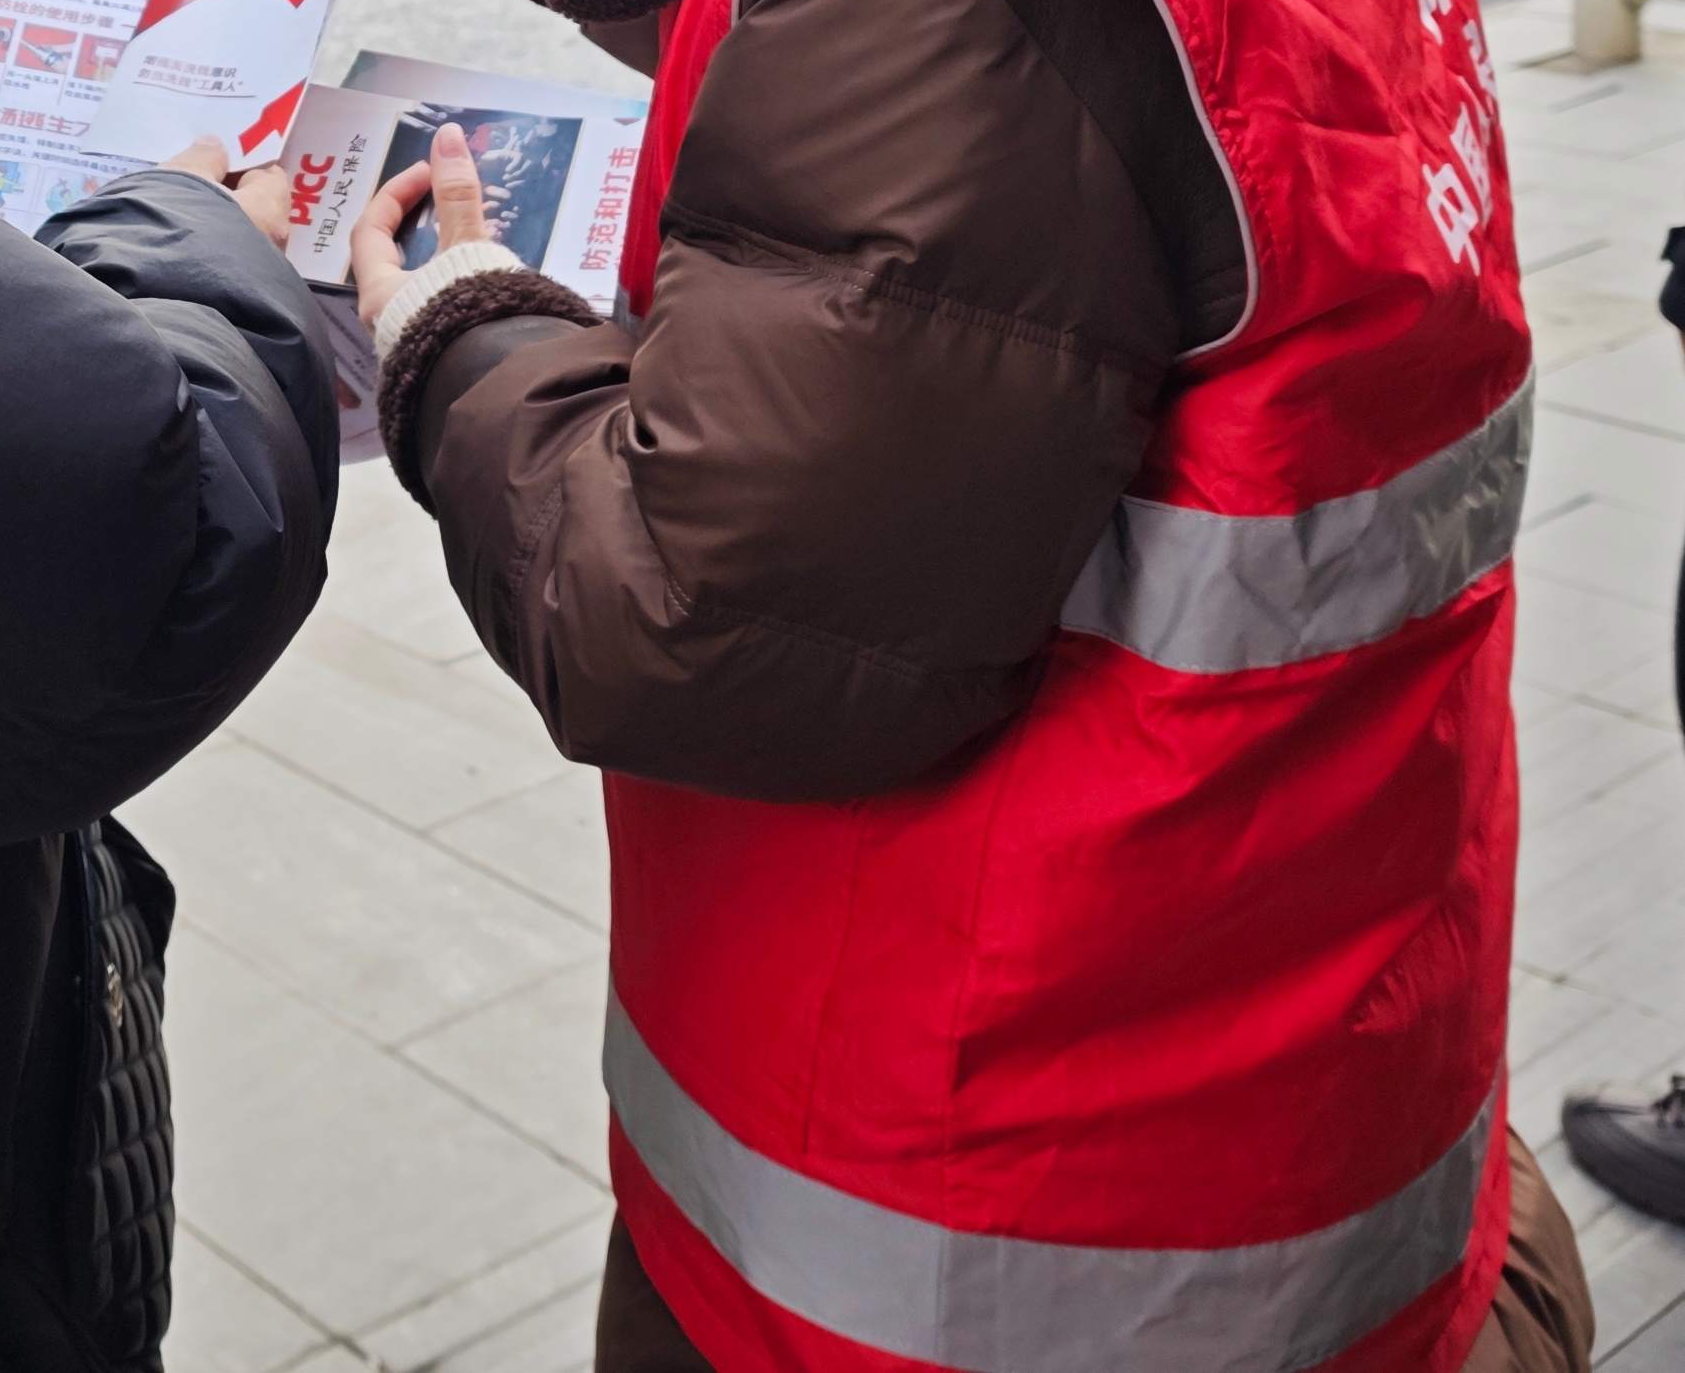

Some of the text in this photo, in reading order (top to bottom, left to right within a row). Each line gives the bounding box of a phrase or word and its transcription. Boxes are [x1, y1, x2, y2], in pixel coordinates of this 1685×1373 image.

[288, 153, 336, 226] PICC
[313, 134, 368, 253] 中国人民保险
[578, 146, 639, 271] 防范和打击
